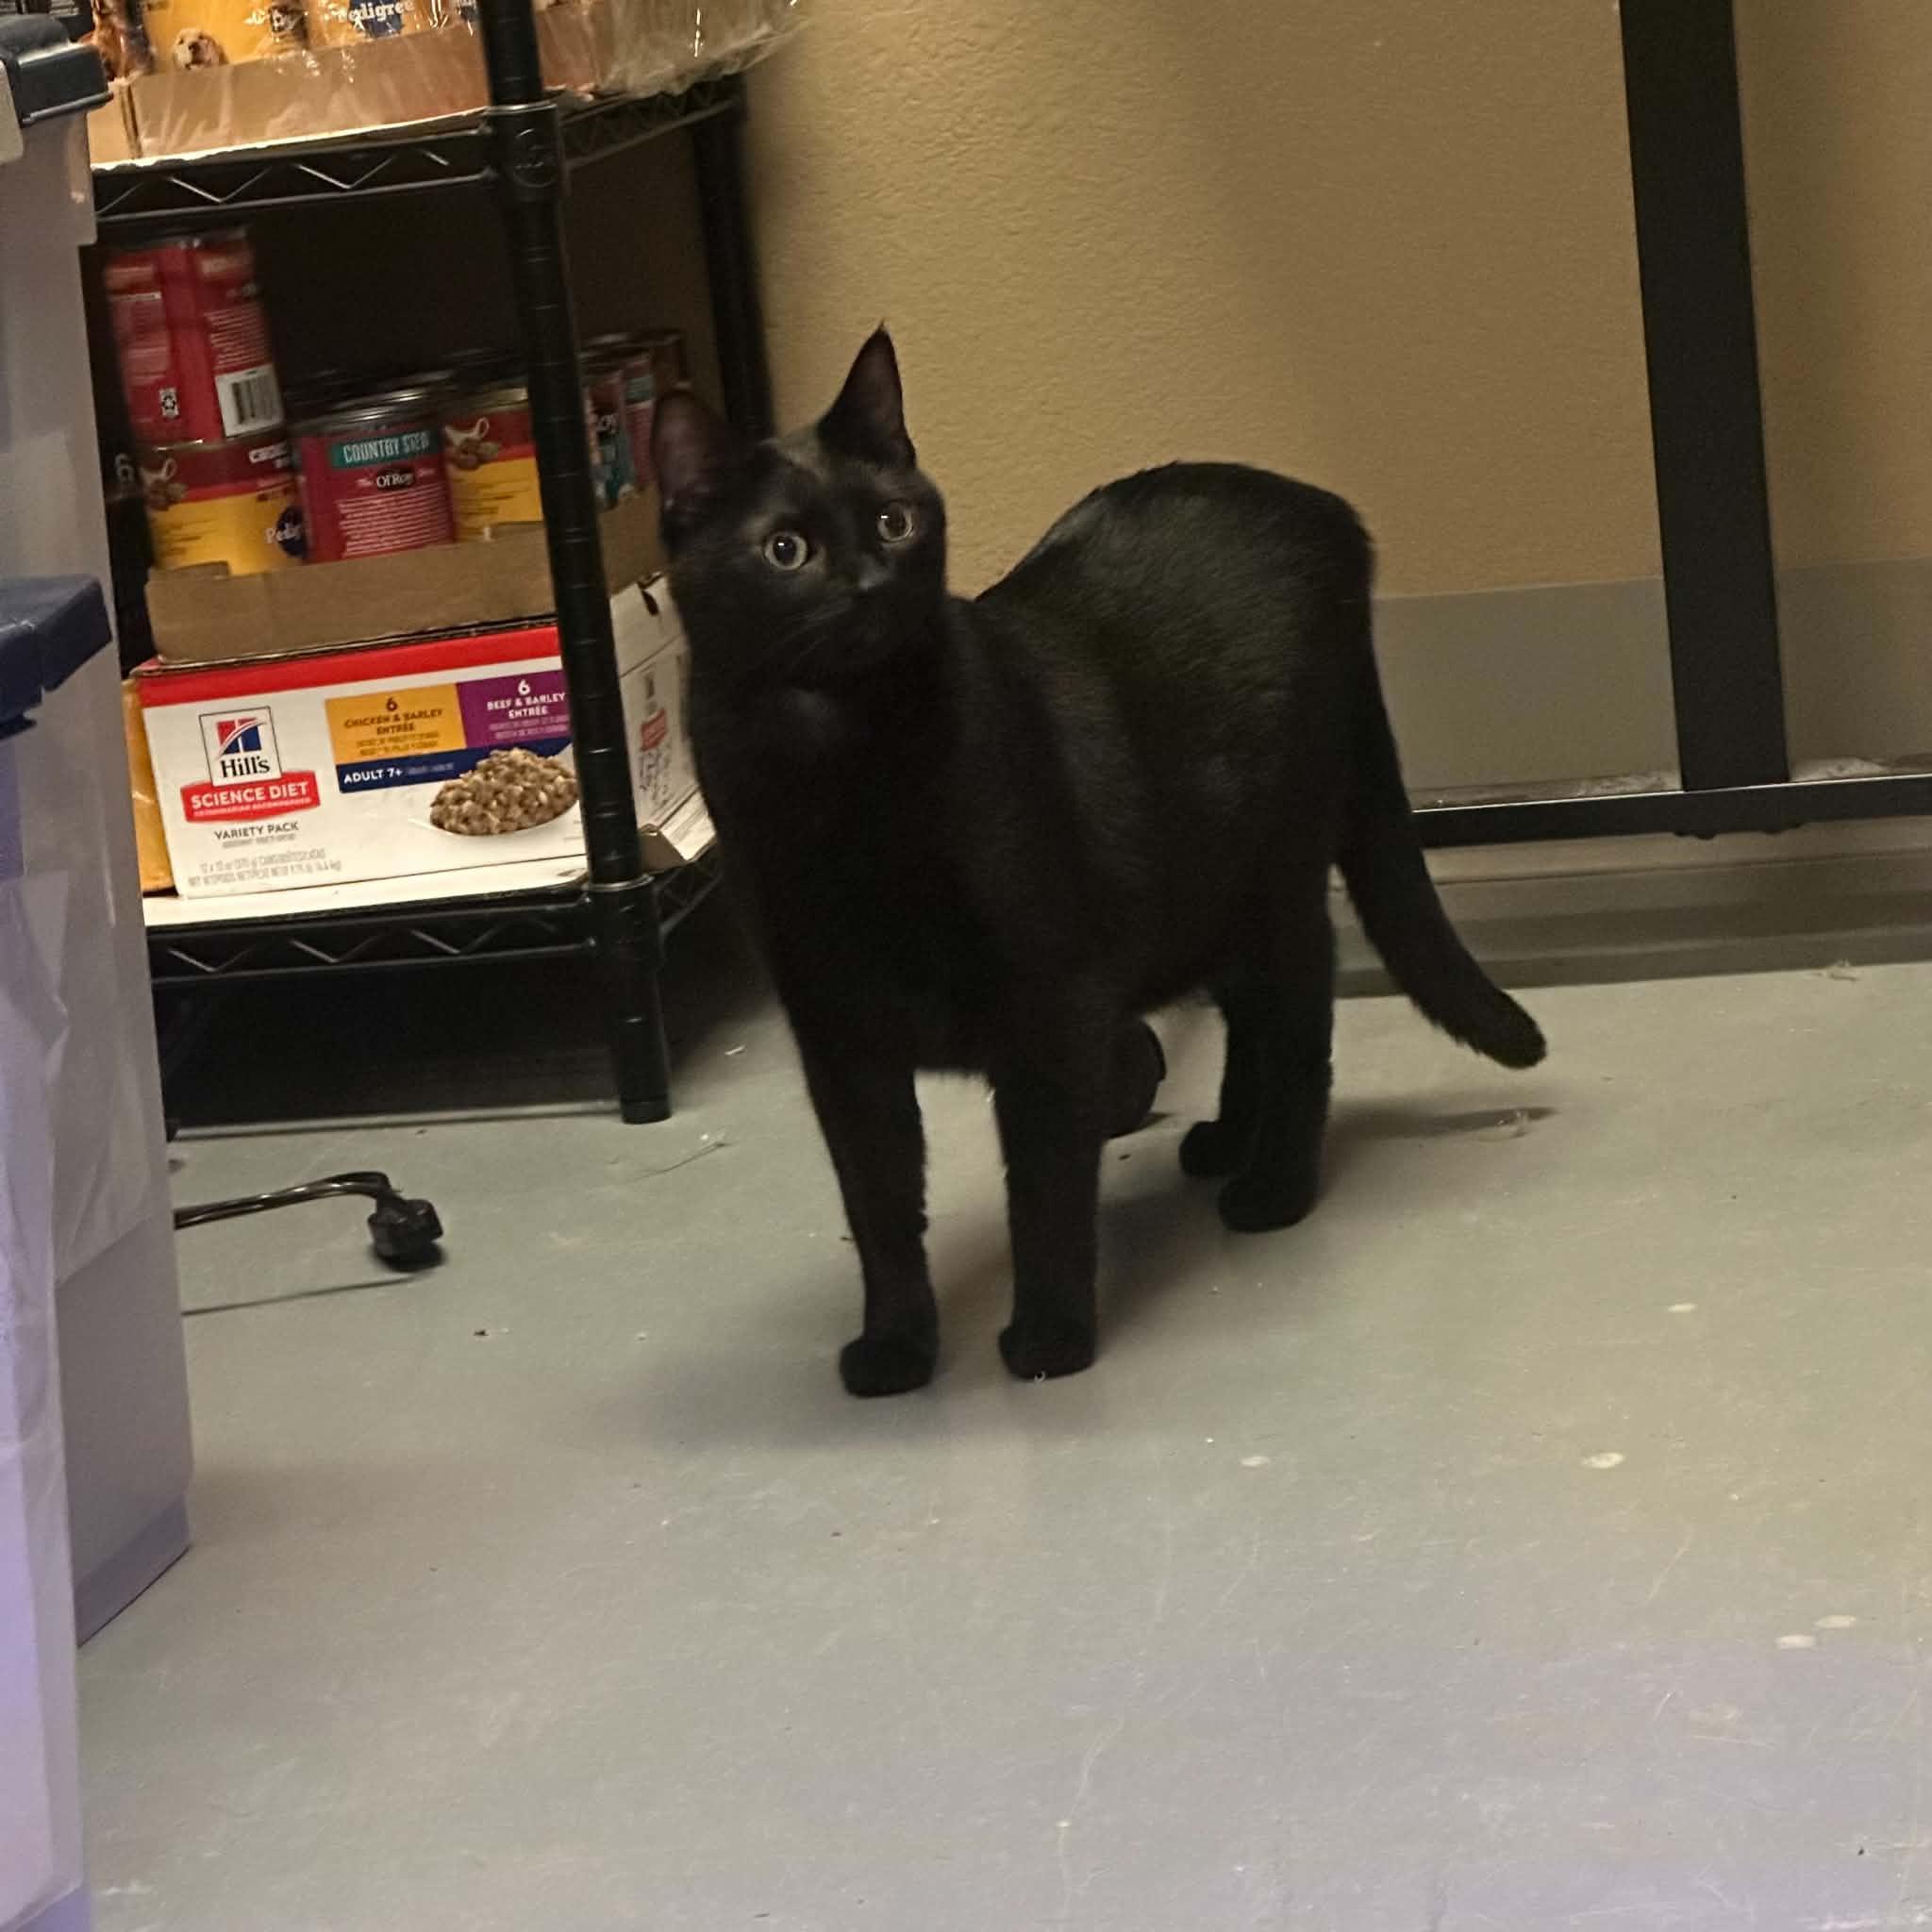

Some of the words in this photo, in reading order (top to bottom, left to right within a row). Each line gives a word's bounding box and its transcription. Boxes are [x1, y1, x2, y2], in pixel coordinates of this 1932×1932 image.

[342, 438, 400, 463] COUNTRY
[518, 679, 531, 695] 6
[386, 697, 398, 711] 6
[487, 699, 511, 710] BEEF
[515, 697, 523, 707] &
[525, 692, 566, 706] BARLEY
[344, 715, 390, 728] CHICKEN
[393, 713, 401, 722] &
[402, 708, 443, 721] BARLEY
[220, 756, 271, 778] Hill's
[343, 769, 383, 784] ADULT
[387, 767, 403, 778] 7+
[191, 787, 265, 809] SCIENCE
[269, 781, 309, 799] DIET
[214, 825, 264, 841] VARIETY
[267, 821, 300, 834] PACK
